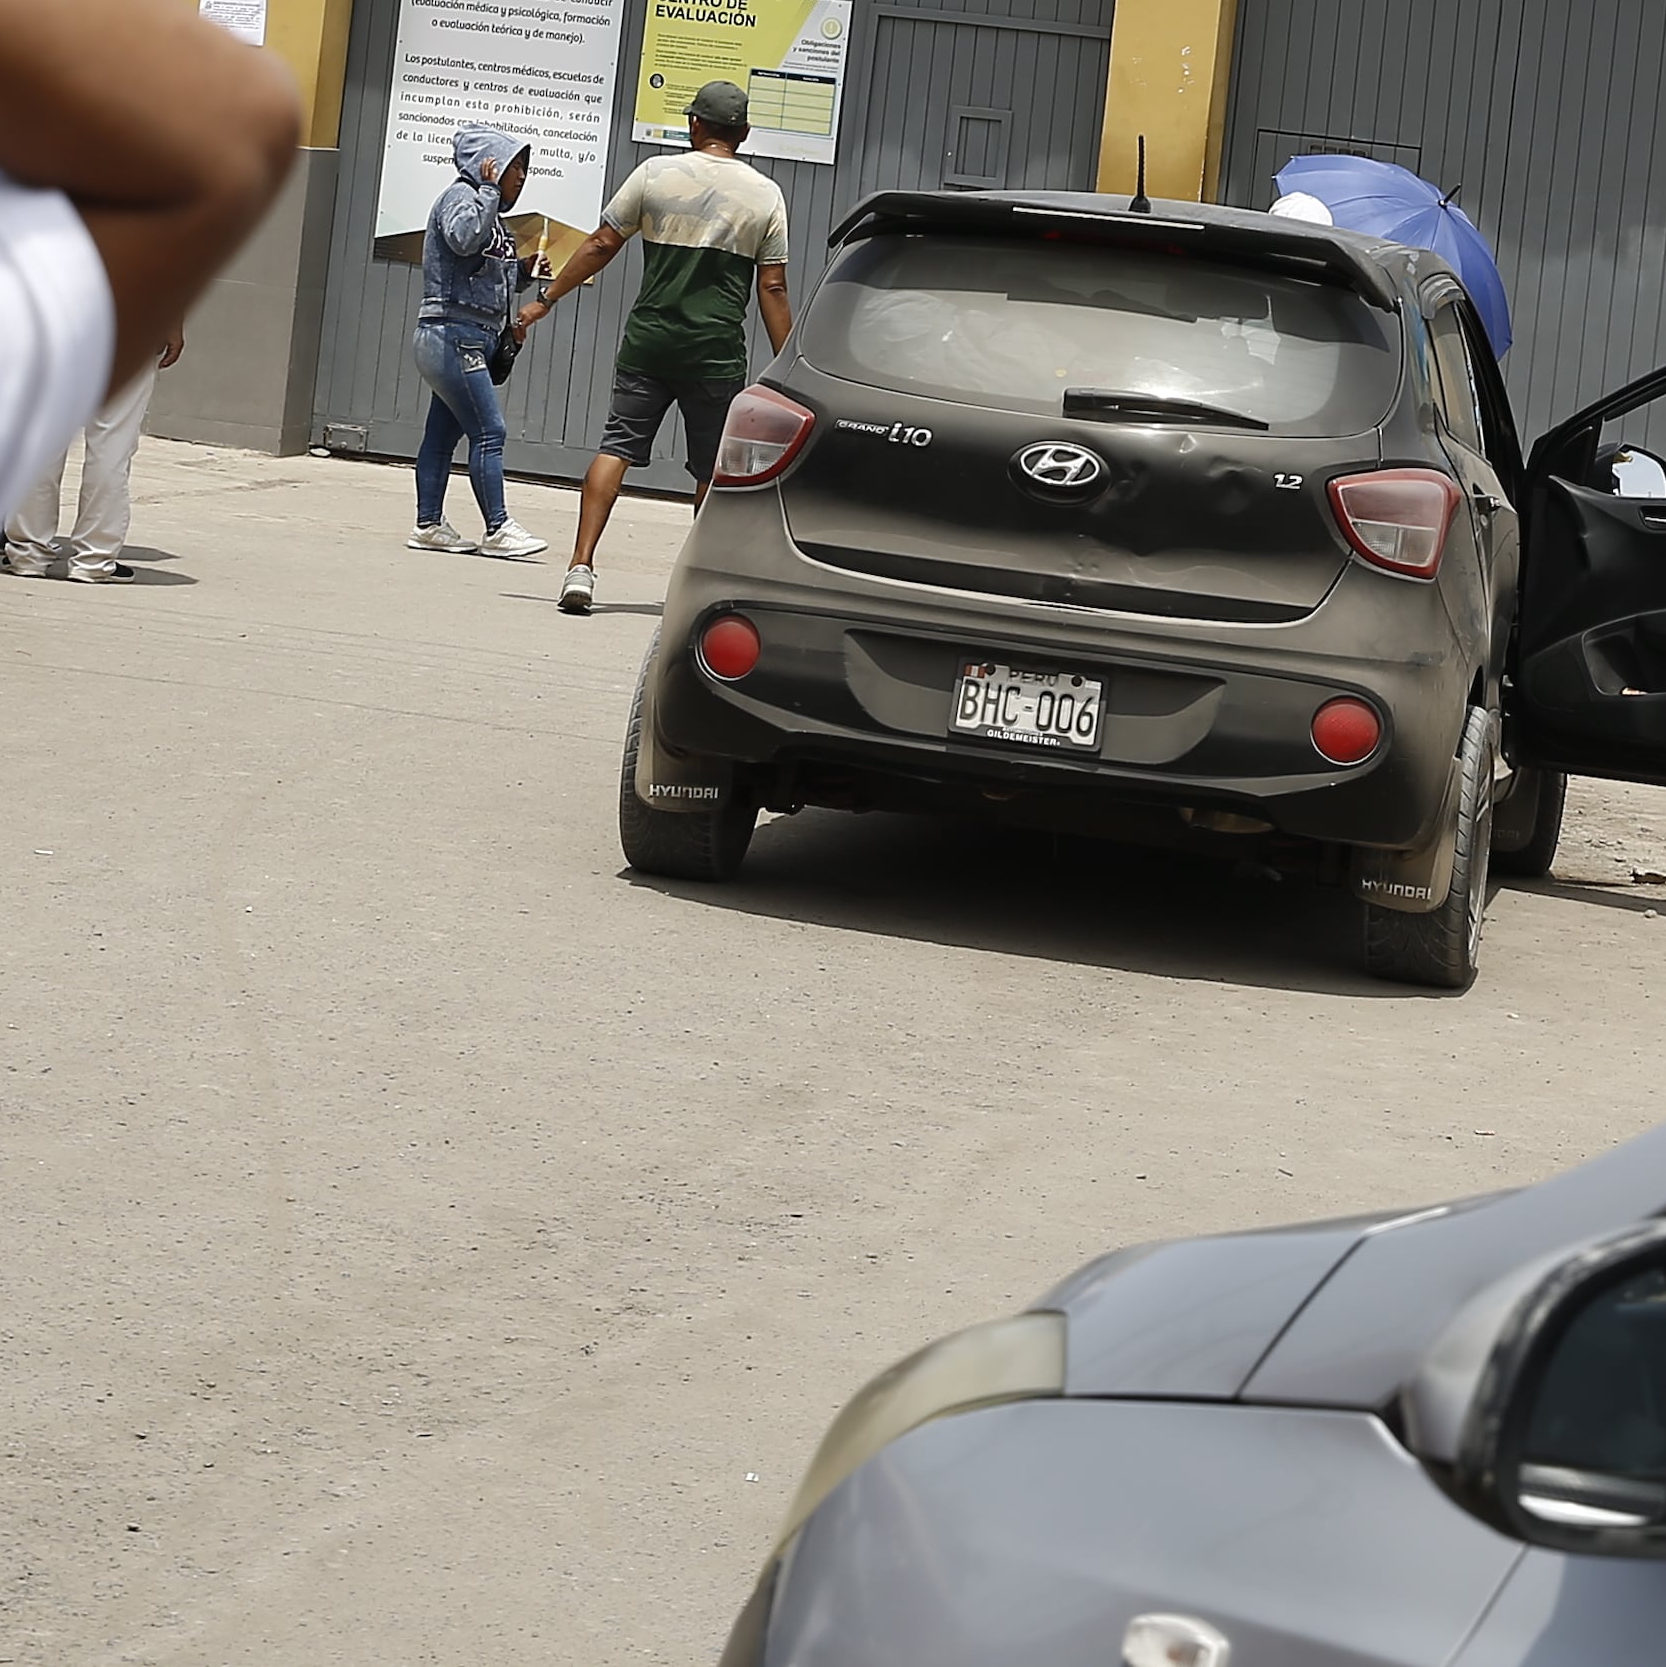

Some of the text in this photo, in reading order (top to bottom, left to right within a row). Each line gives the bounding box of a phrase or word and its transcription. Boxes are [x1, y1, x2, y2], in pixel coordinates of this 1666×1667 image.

[465, 1, 499, 14] médica
[500, 6, 507, 18] y
[507, 6, 562, 22] psicológica,
[562, 11, 611, 26] formación
[655, 3, 756, 27] EVALUACIÓN
[431, 18, 585, 45] o evaluación teórica y de manejo).
[404, 53, 604, 85] Los postulantes, centros médicos, escuelas de
[402, 73, 602, 105] conductores y centros de evaluación que
[400, 91, 600, 123] incumplan esta prohibición, serán
[397, 110, 456, 126] sancionados
[542, 126, 599, 143] cancelación
[395, 129, 409, 141] de
[412, 131, 424, 142] la
[539, 146, 574, 161] multa,
[577, 150, 597, 165] y/o
[837, 420, 932, 447] GRAND i10
[959, 678, 1095, 738] BHC-006
[649, 783, 719, 799] HYUNDAI
[1361, 878, 1432, 900] HYUNDAI
